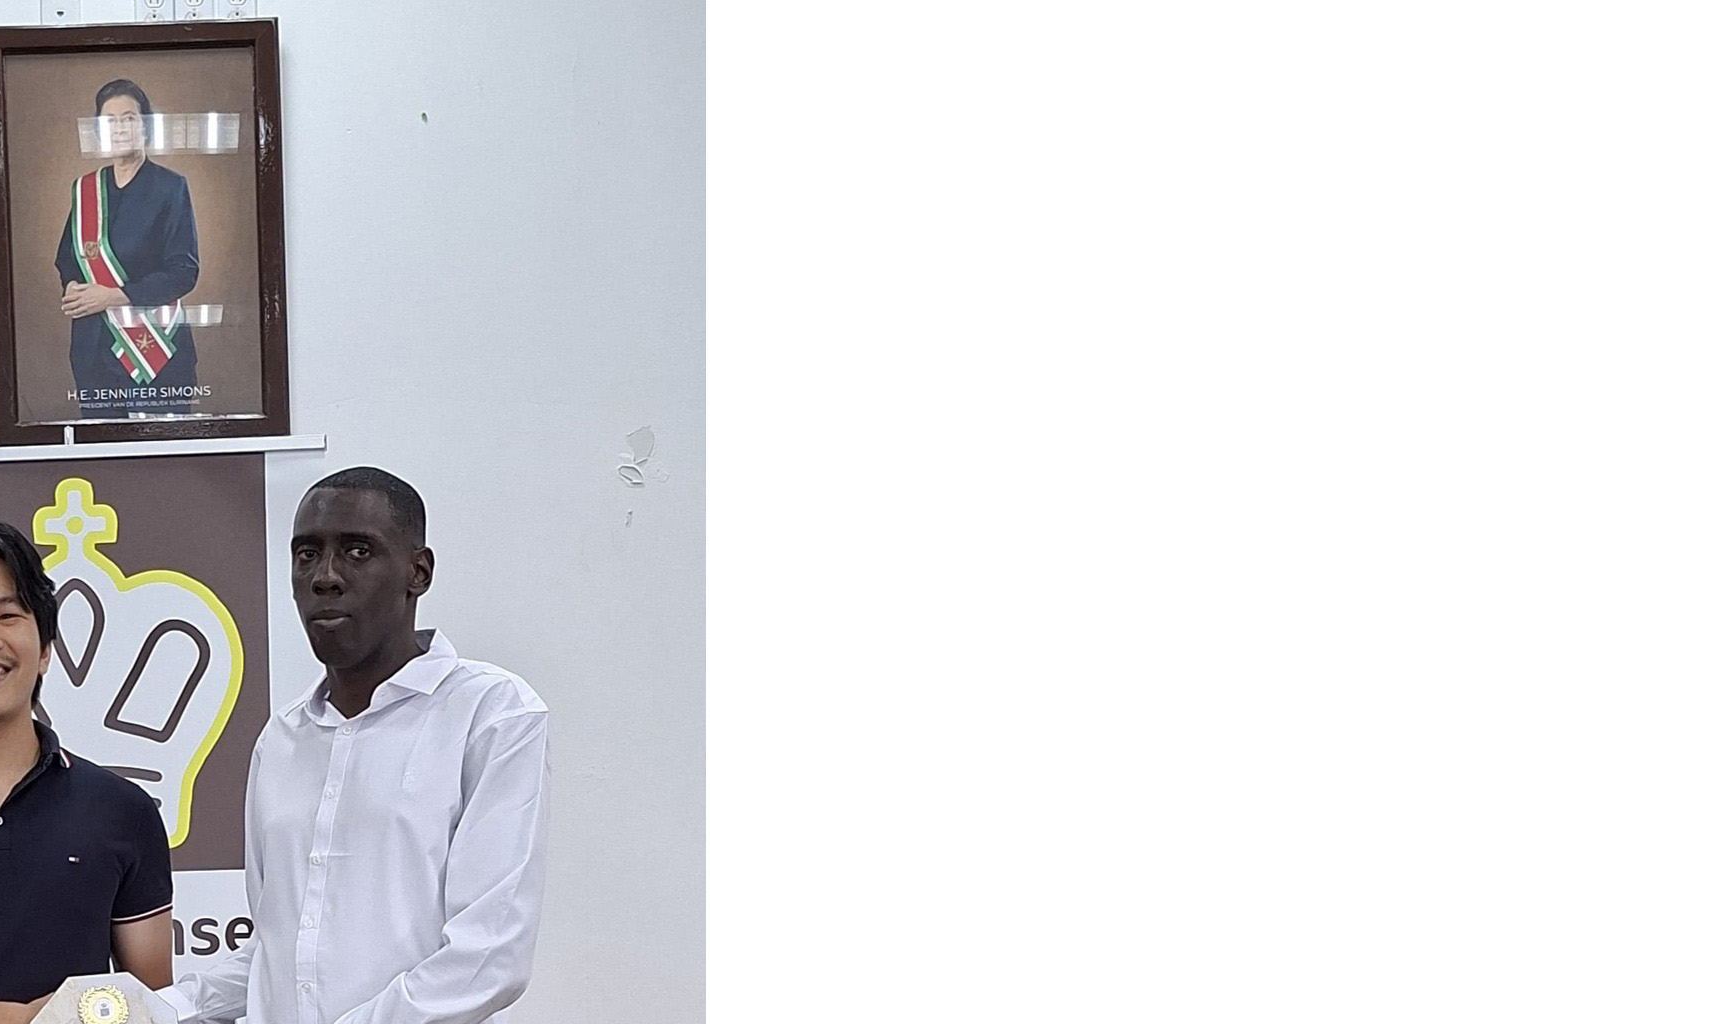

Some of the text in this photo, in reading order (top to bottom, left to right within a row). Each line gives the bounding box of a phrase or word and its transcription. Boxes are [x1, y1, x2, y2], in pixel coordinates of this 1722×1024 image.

[67, 385, 211, 401] H.E. JENNIFER SIMONS
